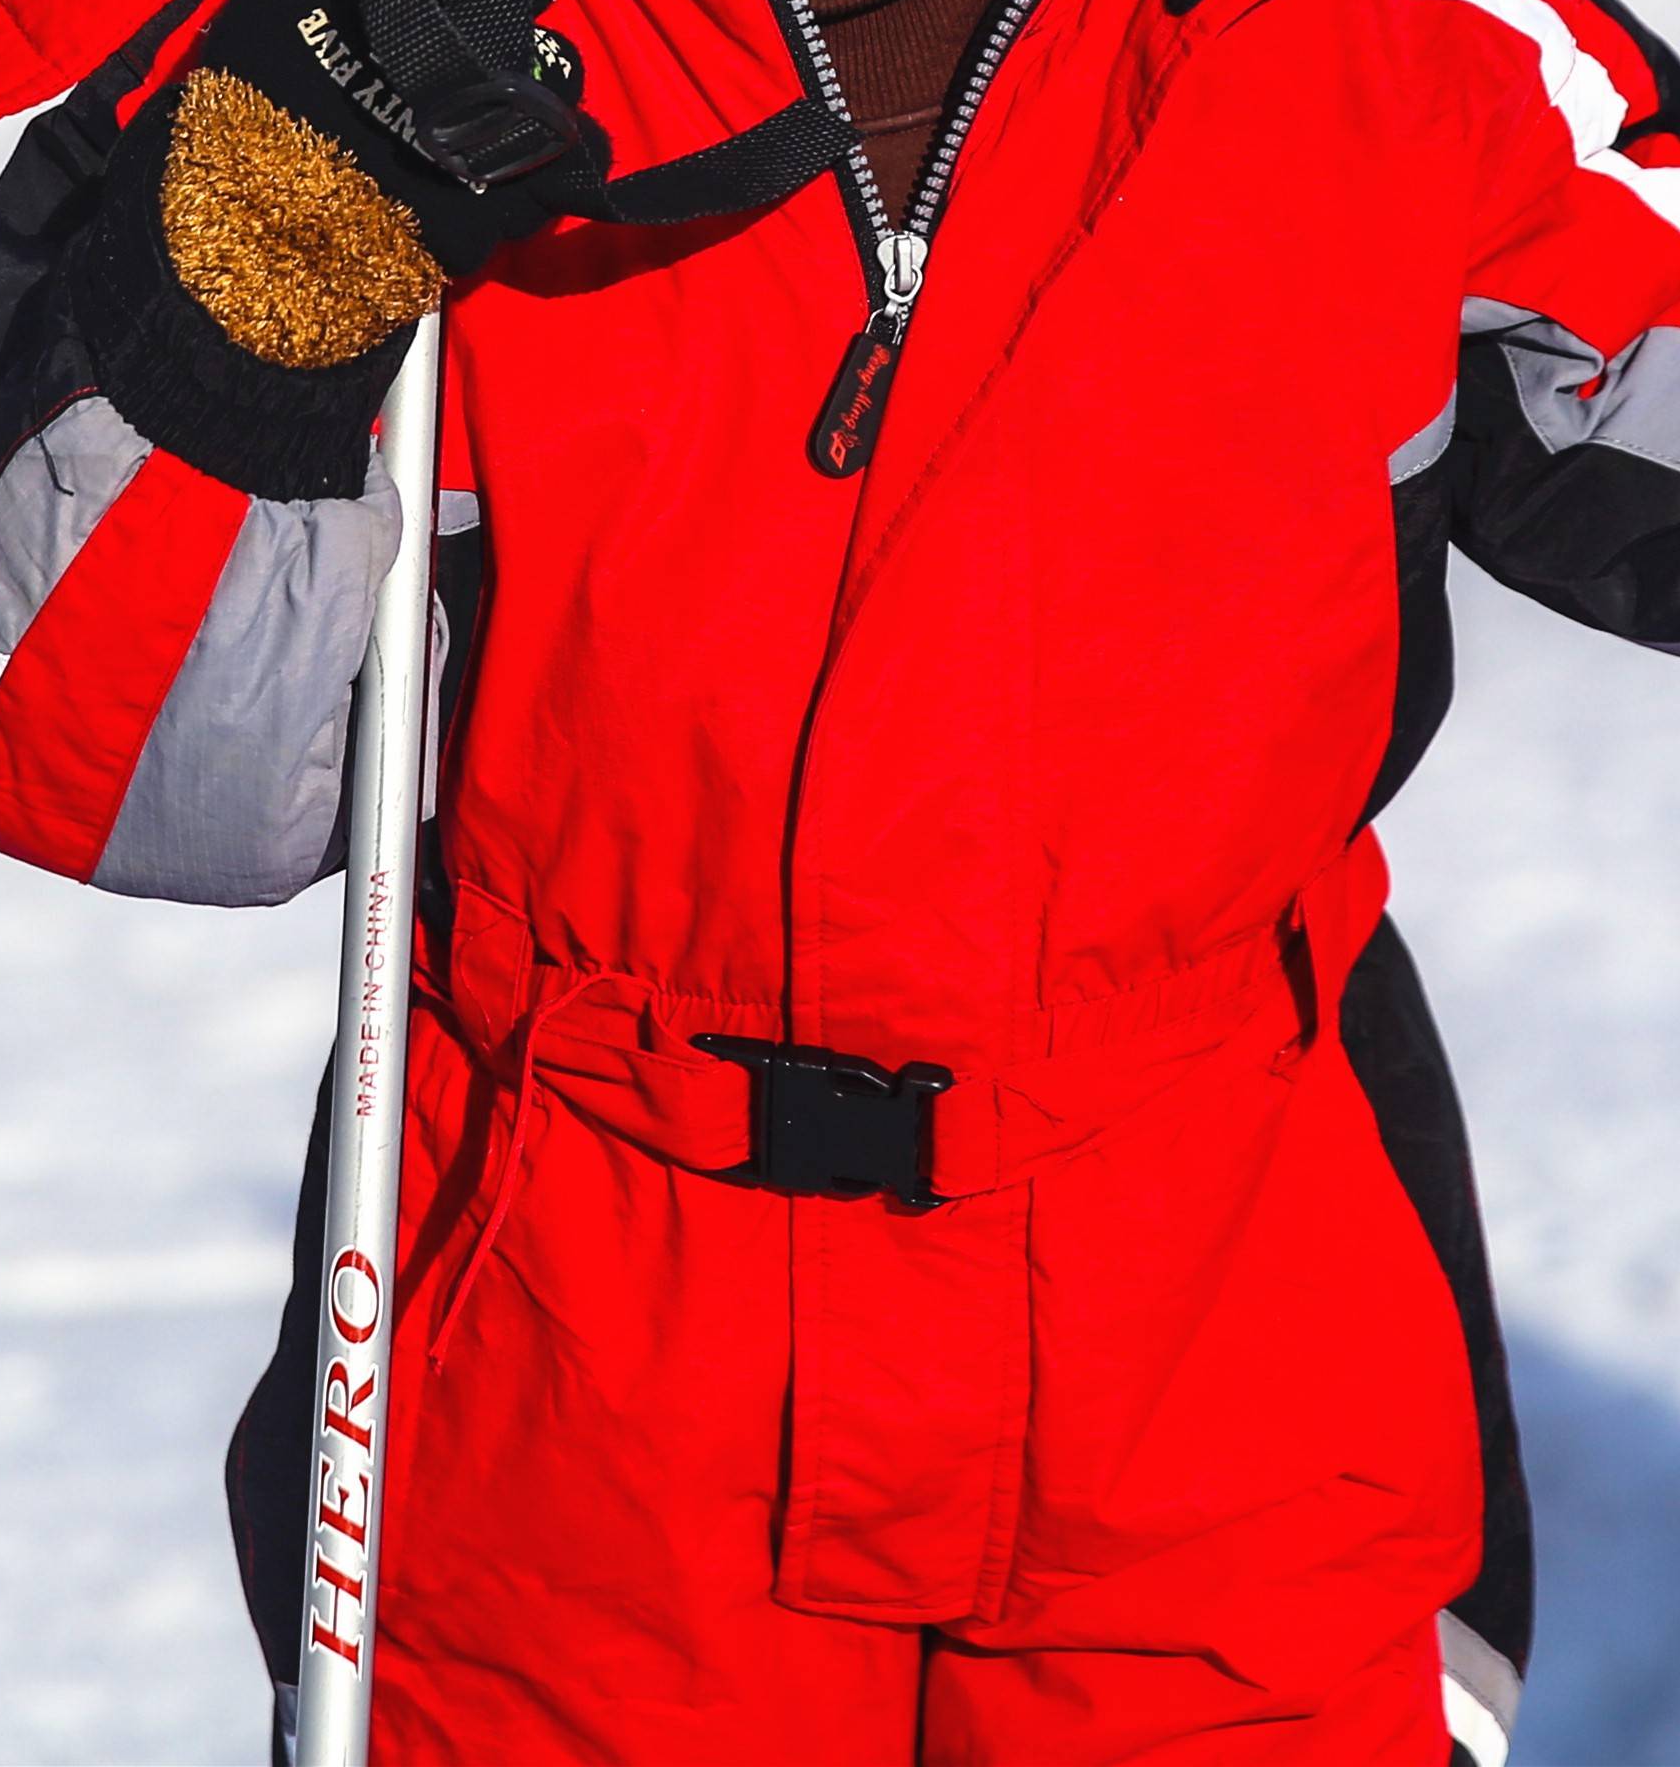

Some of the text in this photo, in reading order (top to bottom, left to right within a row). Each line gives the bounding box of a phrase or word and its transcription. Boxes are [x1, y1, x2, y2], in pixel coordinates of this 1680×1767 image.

[296, 7, 363, 88] FIVE
[356, 870, 389, 1118] MADE IN CHINA
[310, 1244, 384, 1682] HERO
